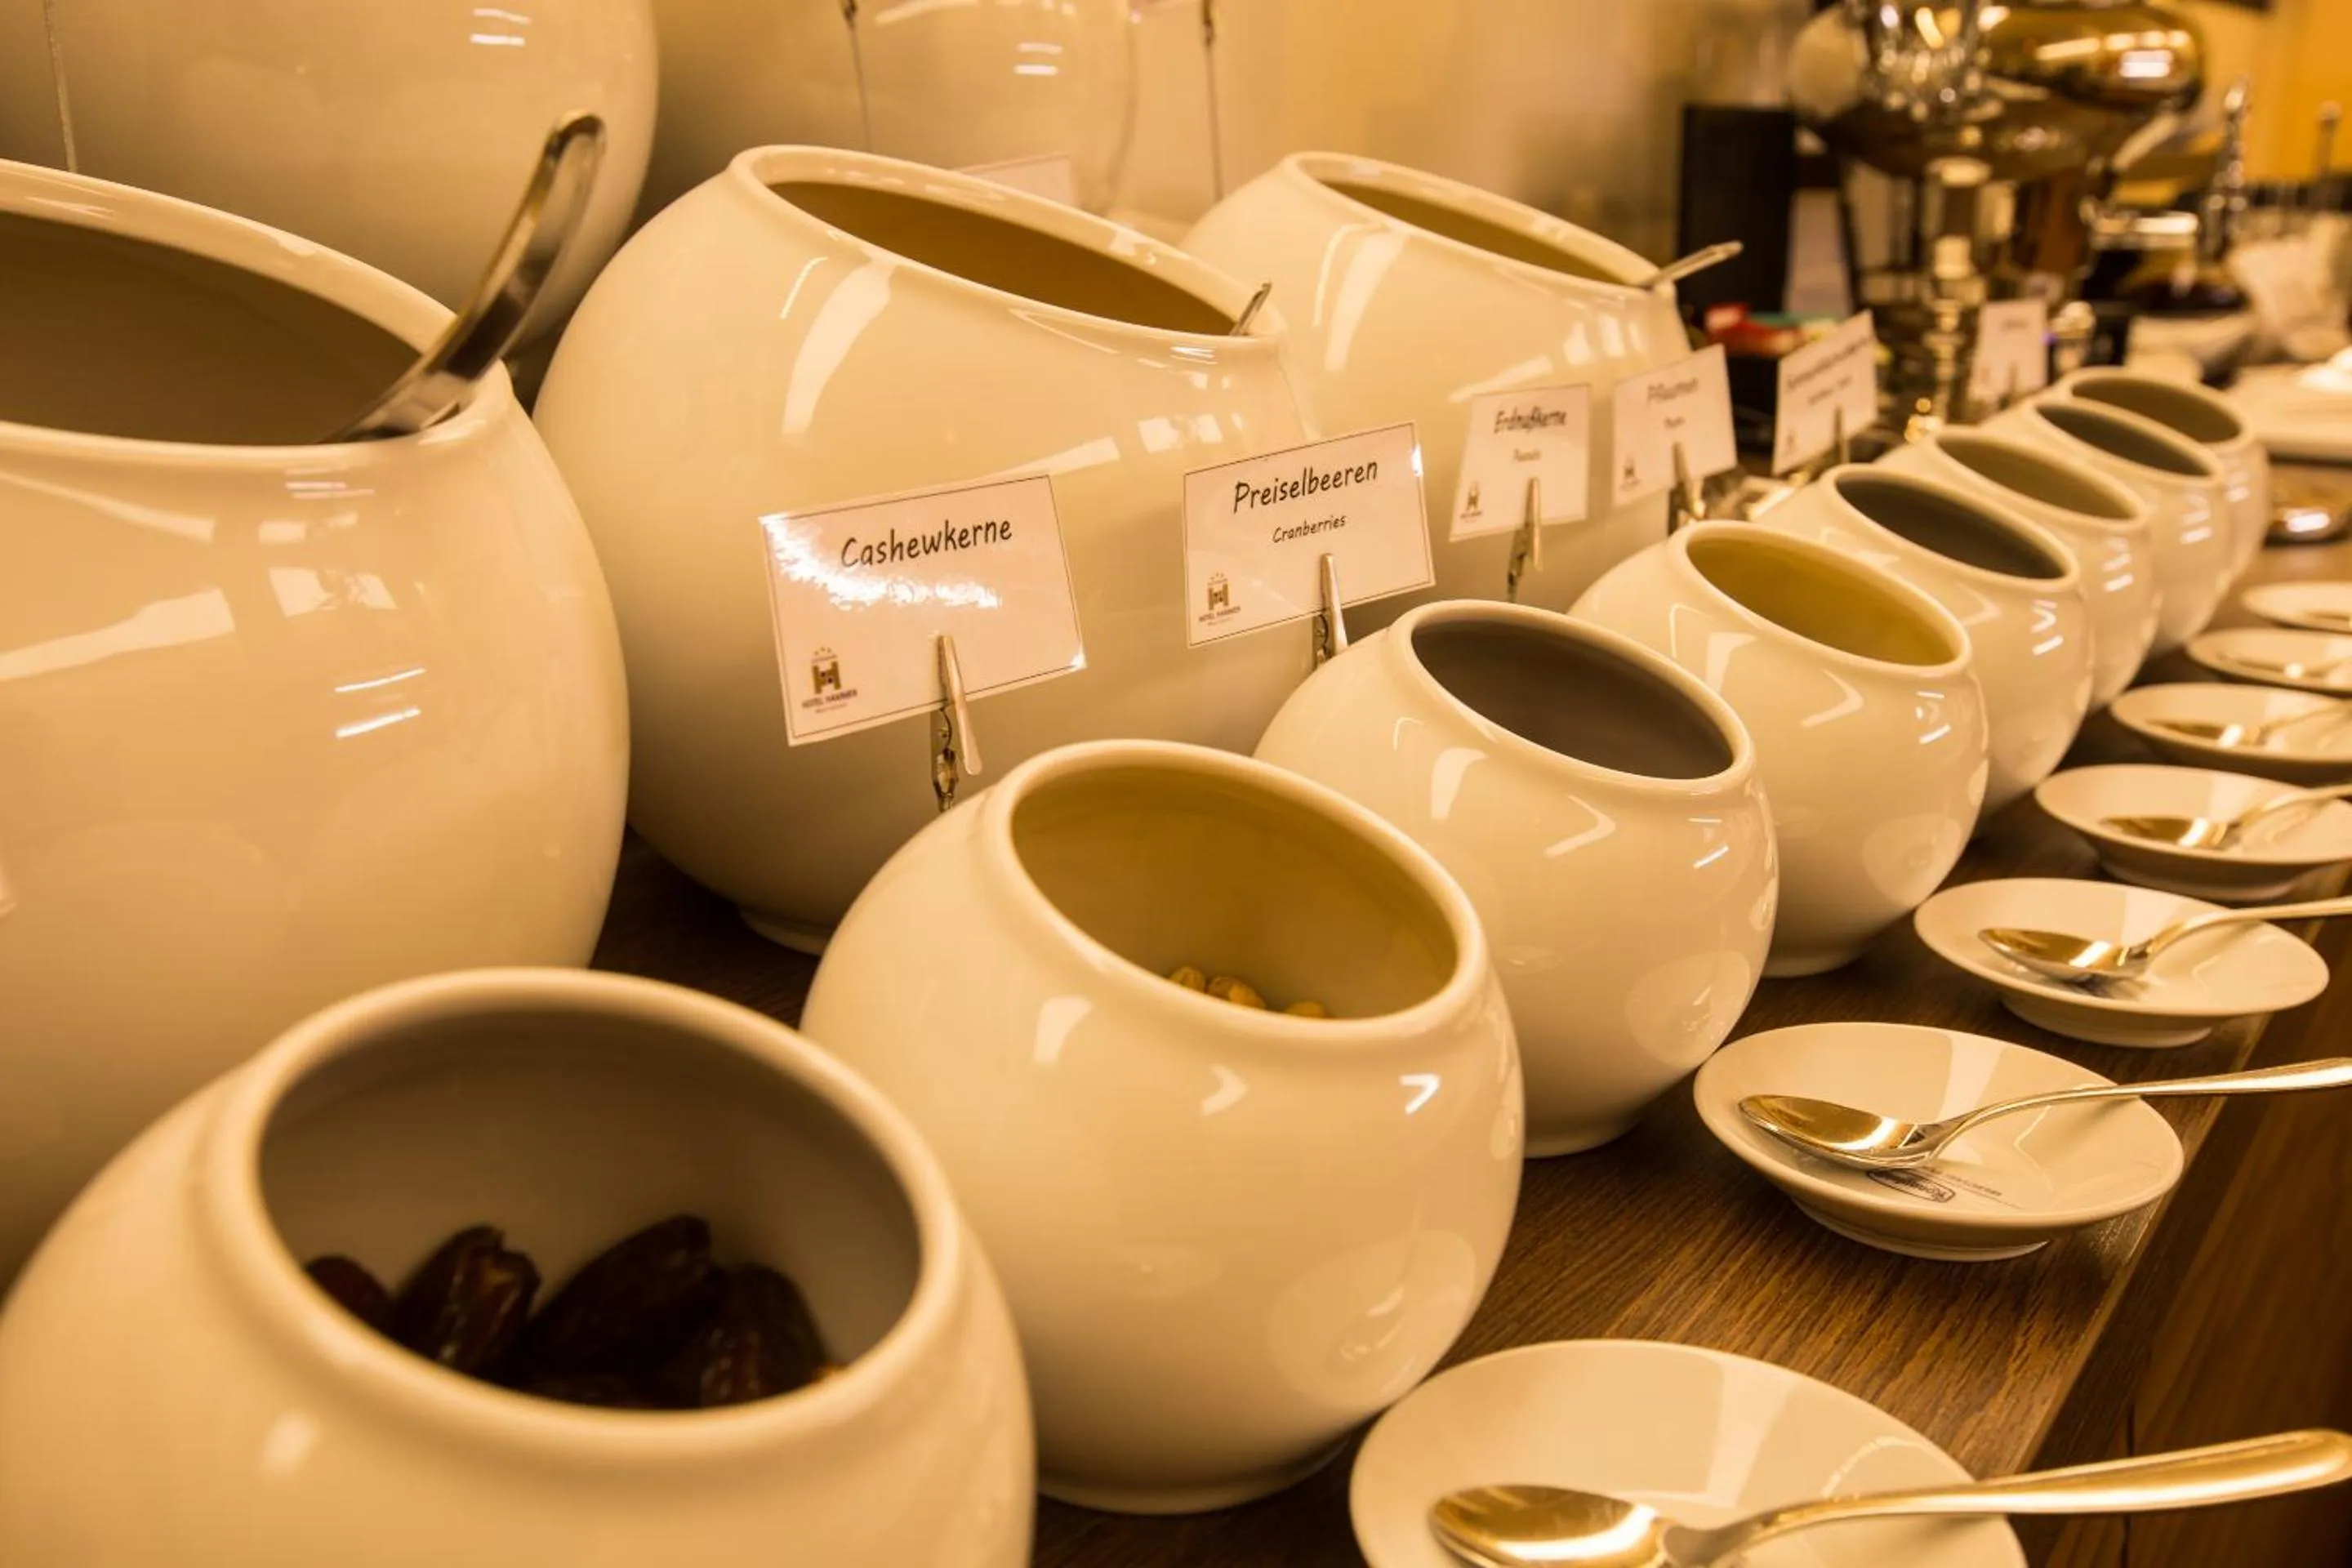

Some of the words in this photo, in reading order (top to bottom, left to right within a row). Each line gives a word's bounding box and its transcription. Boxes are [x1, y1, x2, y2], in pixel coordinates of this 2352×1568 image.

[1233, 461, 1378, 514] Preiselbeeren
[841, 517, 1013, 567] Cashewkerne
[1272, 514, 1347, 543] Cranberries
